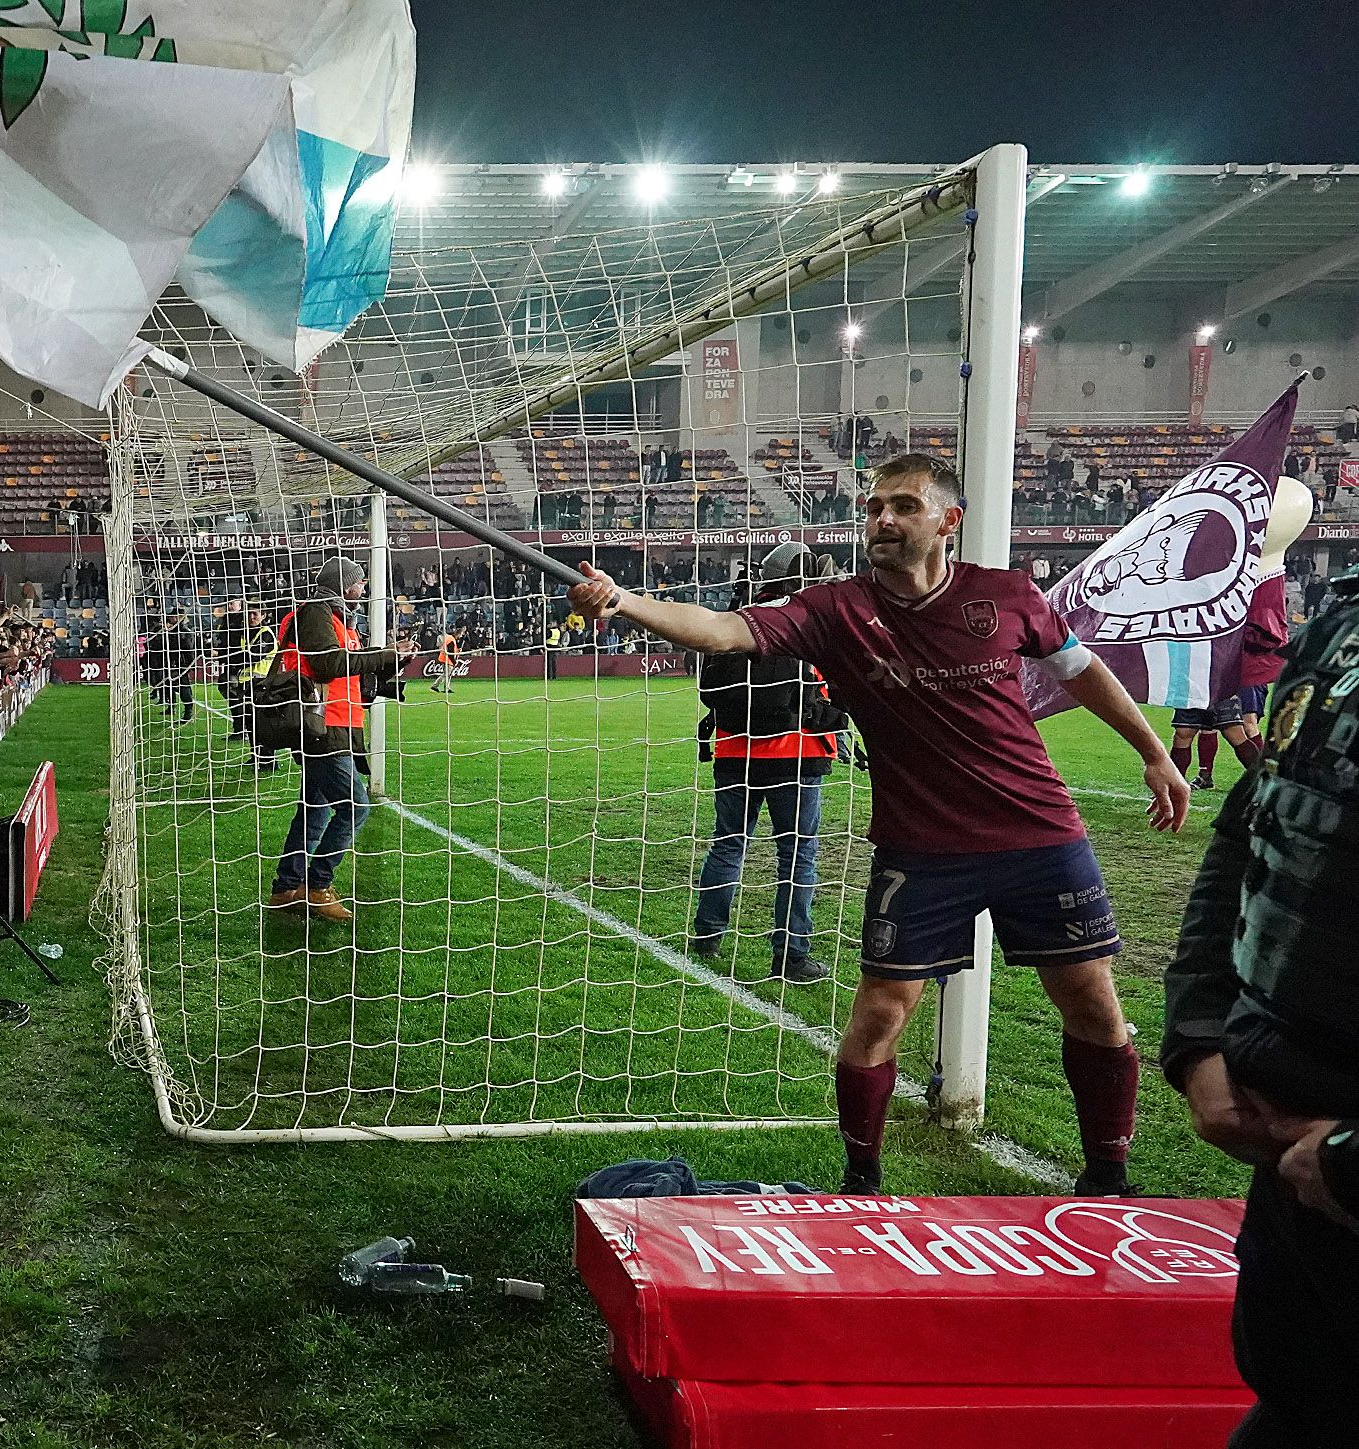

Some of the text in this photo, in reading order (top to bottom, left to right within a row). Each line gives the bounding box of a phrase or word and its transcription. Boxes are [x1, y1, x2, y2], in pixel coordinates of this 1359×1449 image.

[705, 347, 730, 357] FOR
[705, 358, 722, 368] ZA
[705, 379, 735, 389] TEVE
[705, 390, 730, 400] DRA
[604, 531, 643, 541] exalta
[691, 531, 776, 544] Estrella Galicia
[816, 531, 860, 543] Estrella
[1079, 533, 1104, 541] HOTEL
[1318, 526, 1350, 539] Diario
[309, 536, 335, 546] IDC
[339, 536, 370, 546] Caldas
[423, 658, 473, 677] Cocaola
[915, 658, 1010, 679] Deputación
[878, 870, 907, 915] 7
[1076, 885, 1100, 898] XUNTA
[1076, 897, 1088, 905] DE
[737, 1196, 923, 1217] MAPFRE
[677, 1223, 1097, 1278] COPA DEL REY
